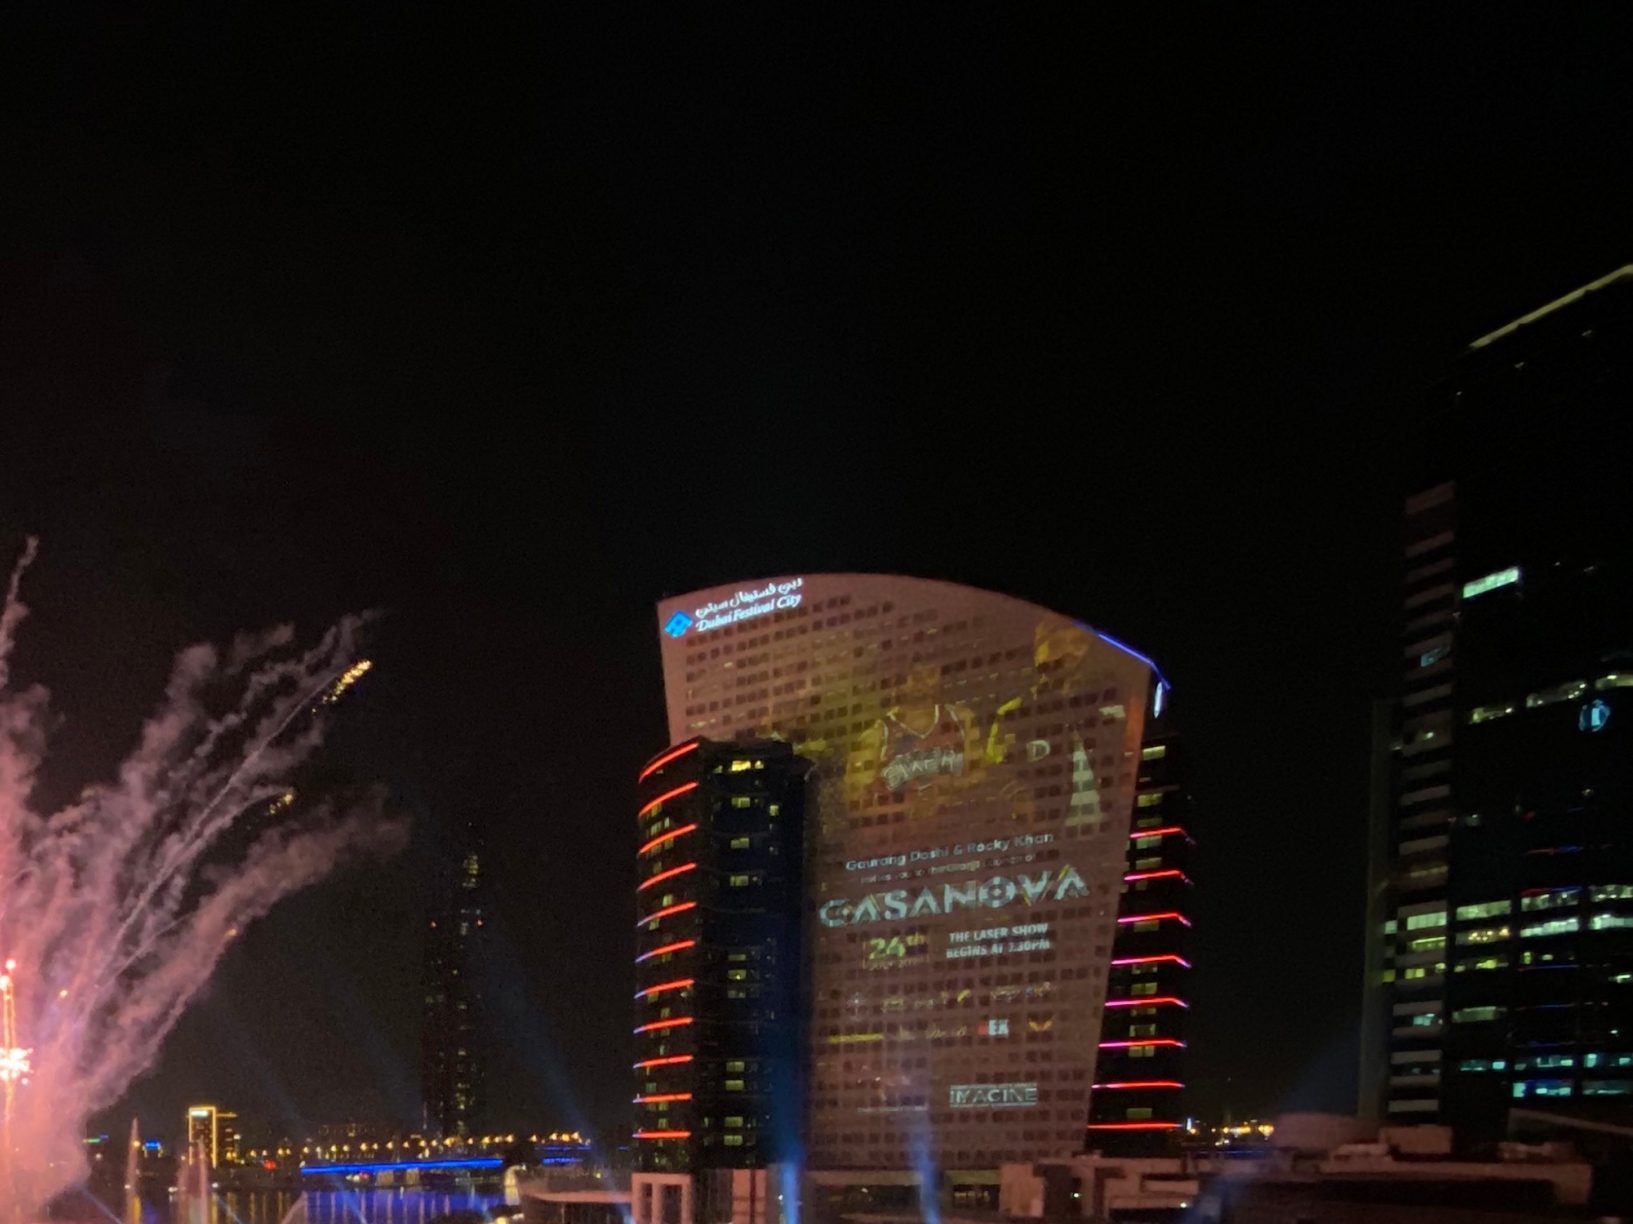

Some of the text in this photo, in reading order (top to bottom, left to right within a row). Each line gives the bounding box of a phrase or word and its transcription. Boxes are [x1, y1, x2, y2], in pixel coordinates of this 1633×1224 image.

[696, 594, 802, 632] Dubai Festival City
[846, 855, 906, 871] Gaurang
[911, 846, 950, 861] Doshi
[968, 839, 1010, 853] Rocky
[1014, 833, 1054, 847] Khan
[819, 864, 1090, 928] CASANOVA
[949, 922, 1049, 943] THE LASER SHOW
[946, 945, 988, 959] BEGINS
[950, 1087, 1038, 1104] IMAGINE
